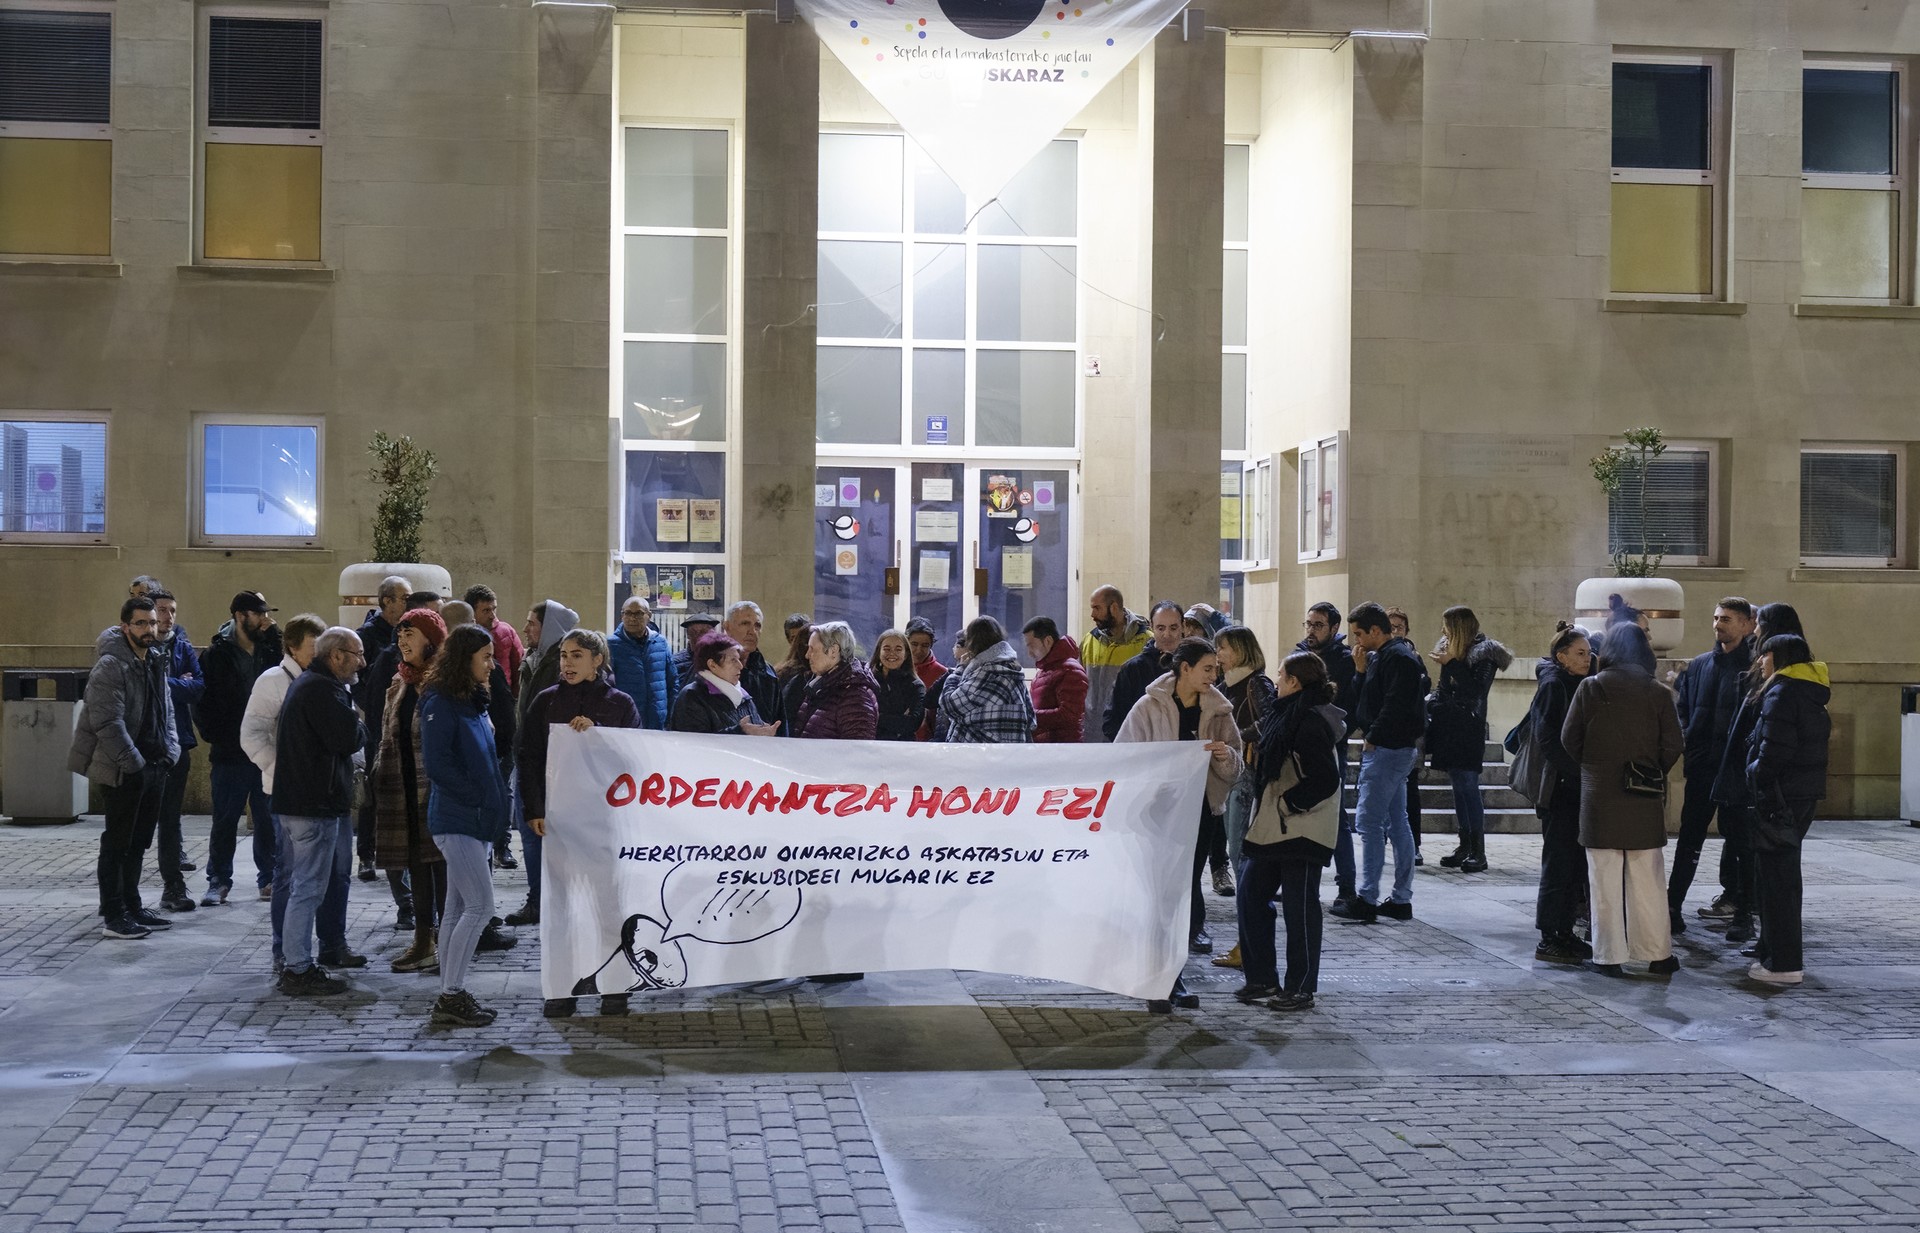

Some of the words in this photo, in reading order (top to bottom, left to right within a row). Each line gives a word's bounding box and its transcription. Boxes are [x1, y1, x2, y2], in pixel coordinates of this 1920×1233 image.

[932, 46, 951, 59] eta
[983, 68, 1065, 83] SKARAZ
[606, 772, 898, 817] ORDENANTZA
[906, 785, 1021, 819] HONI
[1036, 780, 1116, 832] EZ!
[618, 844, 768, 862] HERRITARRON
[776, 845, 910, 862] OINARRIZKO
[920, 846, 1045, 863] ASKATASUN
[1051, 848, 1090, 863] ETA
[716, 868, 841, 886] ESKUBIDEEI
[850, 868, 959, 885] MUGARIK
[966, 869, 995, 885] EZ
